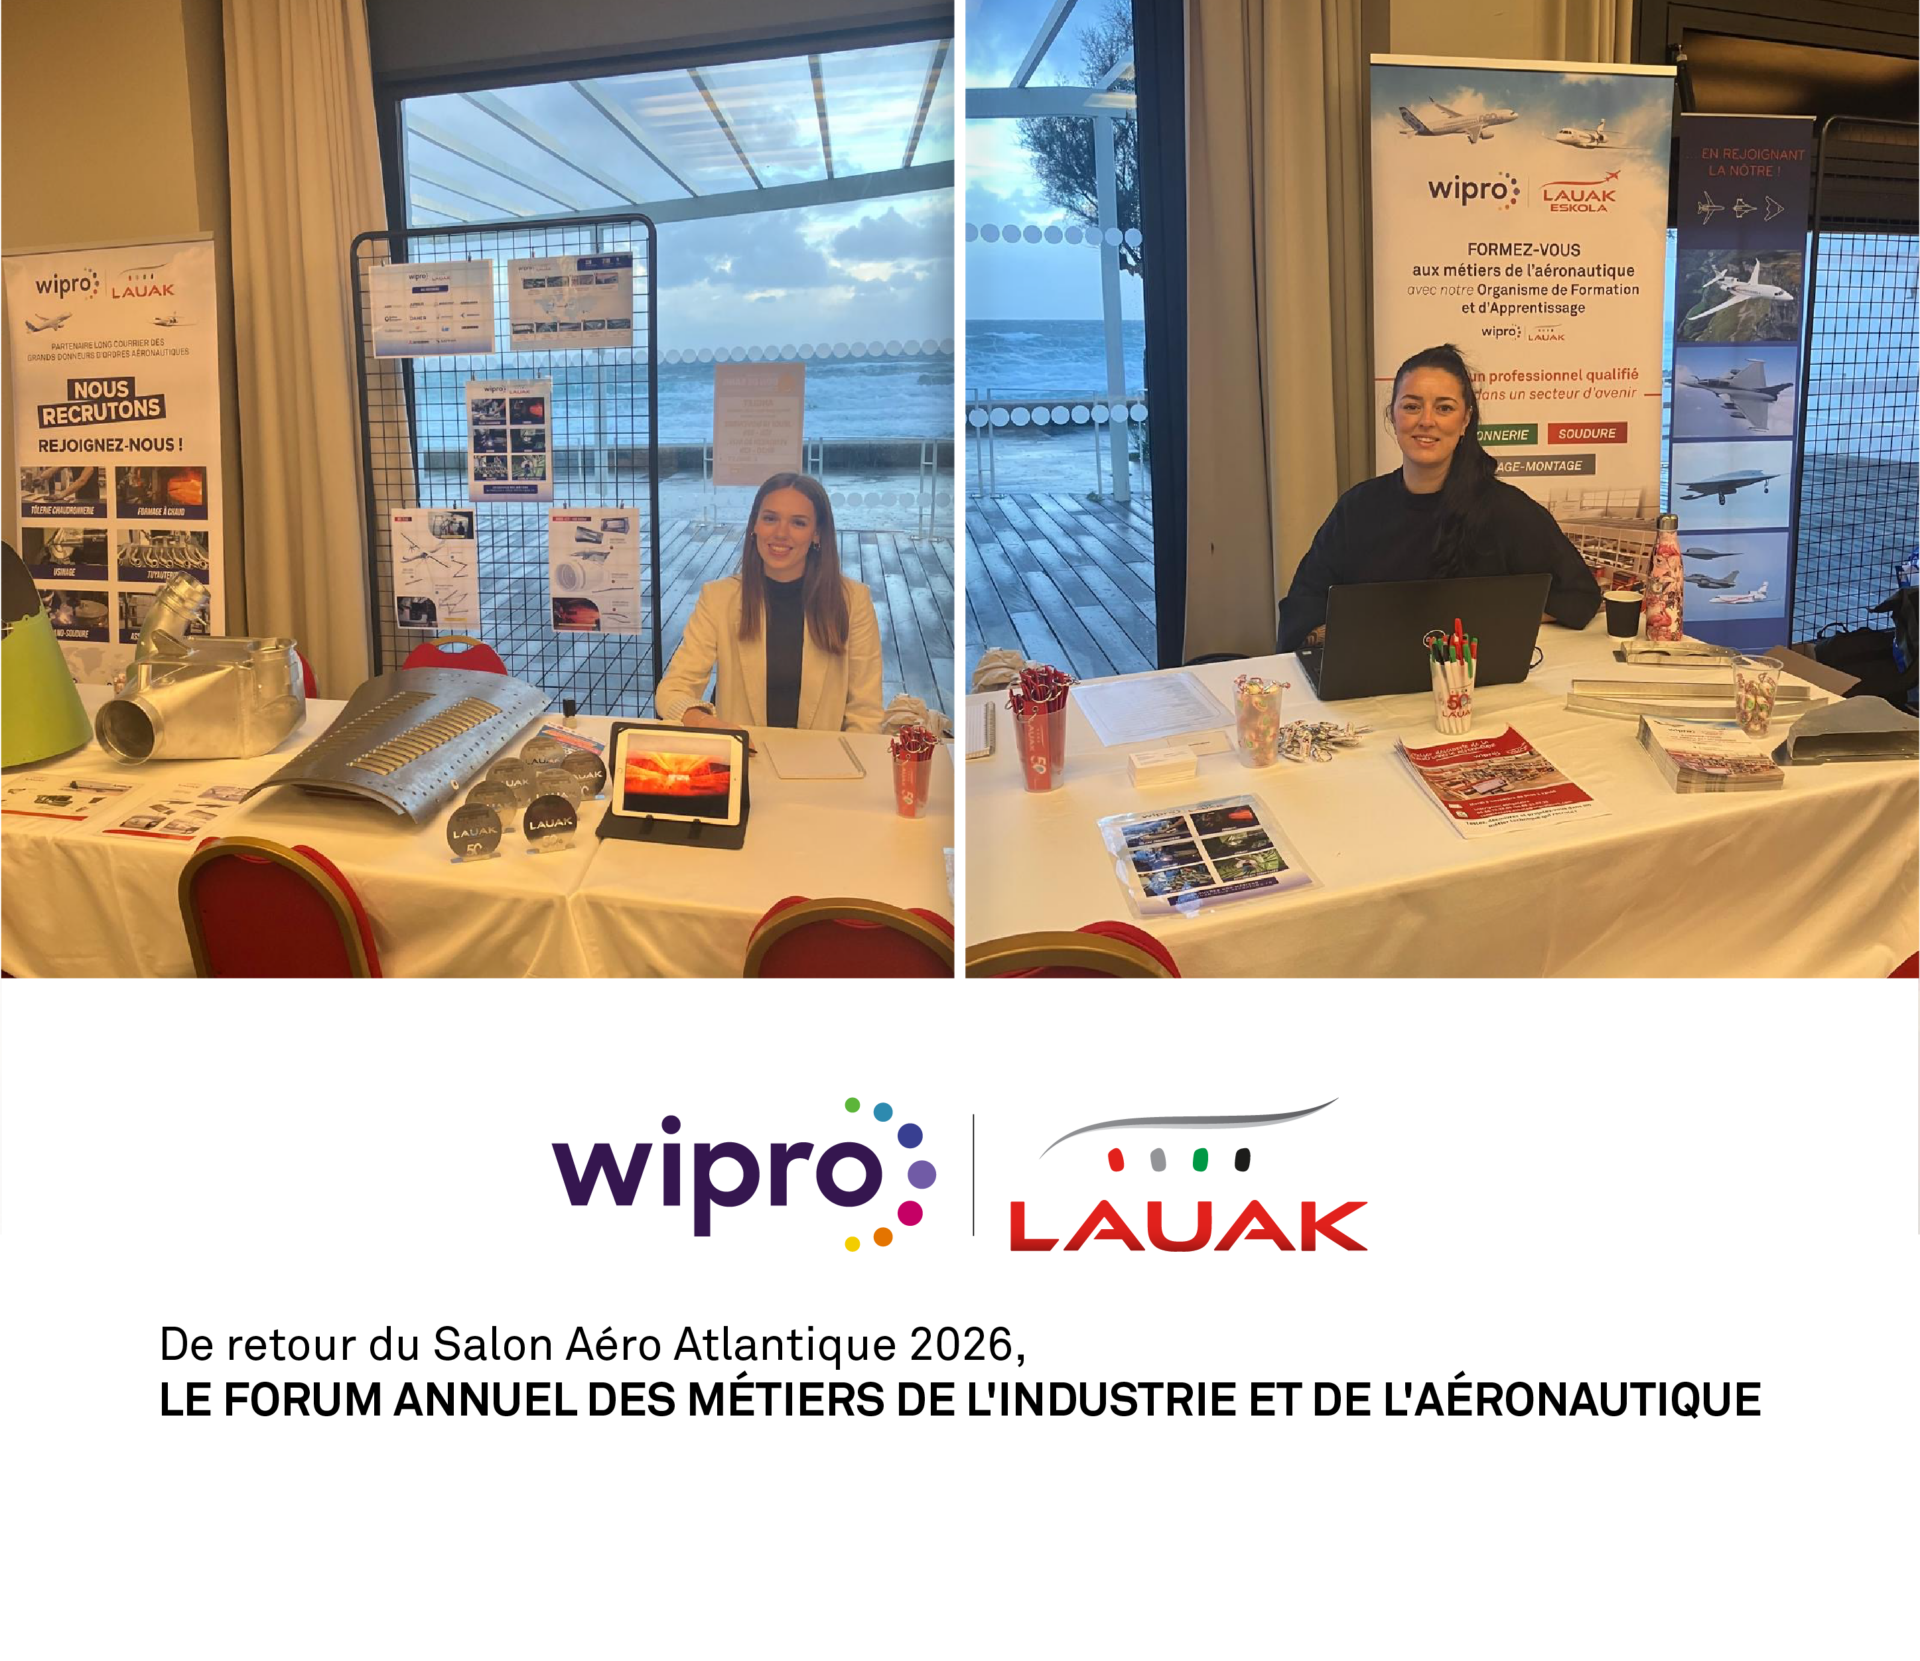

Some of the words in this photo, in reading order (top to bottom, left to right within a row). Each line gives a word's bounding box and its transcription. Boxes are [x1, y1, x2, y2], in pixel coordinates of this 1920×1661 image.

[1702, 148, 1719, 159] EN
[1724, 149, 1805, 160] REJOIGNANT
[1709, 165, 1726, 176] LA
[1730, 163, 1773, 176] NÔTRE
[1428, 175, 1508, 206] wipro
[1543, 189, 1616, 202] LAUAK
[1550, 203, 1608, 212] ESKOLA
[1467, 242, 1581, 257] FORMEZ-VOUS
[1412, 267, 1439, 277] aux
[1444, 263, 1501, 277] métiers
[1505, 263, 1523, 277] de
[1527, 263, 1635, 281] l'aéronautique
[35, 273, 91, 299] wipro
[112, 284, 175, 299] LAUAK
[1407, 285, 1437, 296] avec
[1440, 284, 1474, 296] notre
[1477, 284, 1548, 299] Organisme
[1551, 284, 1567, 295] de
[1571, 284, 1640, 295] Formation
[1461, 303, 1475, 313] et
[1478, 302, 1586, 317] d'Apprentissage
[1481, 326, 1516, 339] wipro
[1528, 333, 1565, 341] LAUAK
[51, 341, 94, 351] PARTENAIRE
[93, 341, 113, 349] LONG
[113, 339, 150, 348] COURRIER
[27, 353, 56, 362] GRANDS
[57, 351, 95, 361] DONNEURS
[131, 347, 190, 358] AÉRONAUTIQUES
[1489, 369, 1583, 384] professionnel
[1585, 367, 1639, 383] qualifié
[74, 380, 129, 400] NOUS
[1476, 388, 1505, 400] dans
[1509, 391, 1525, 400] un
[1529, 388, 1579, 400] secteur
[1583, 386, 1637, 399] d'avenir
[42, 398, 160, 426] RECRUTONS
[1558, 428, 1617, 439] SOUDURE
[39, 438, 175, 452] REJOIGNEZ-NOUS
[1497, 460, 1583, 472] AGE-MONTAGE
[1442, 709, 1471, 718] LAUA
[529, 817, 573, 831] LAUAK
[453, 827, 498, 839] LAUAK
